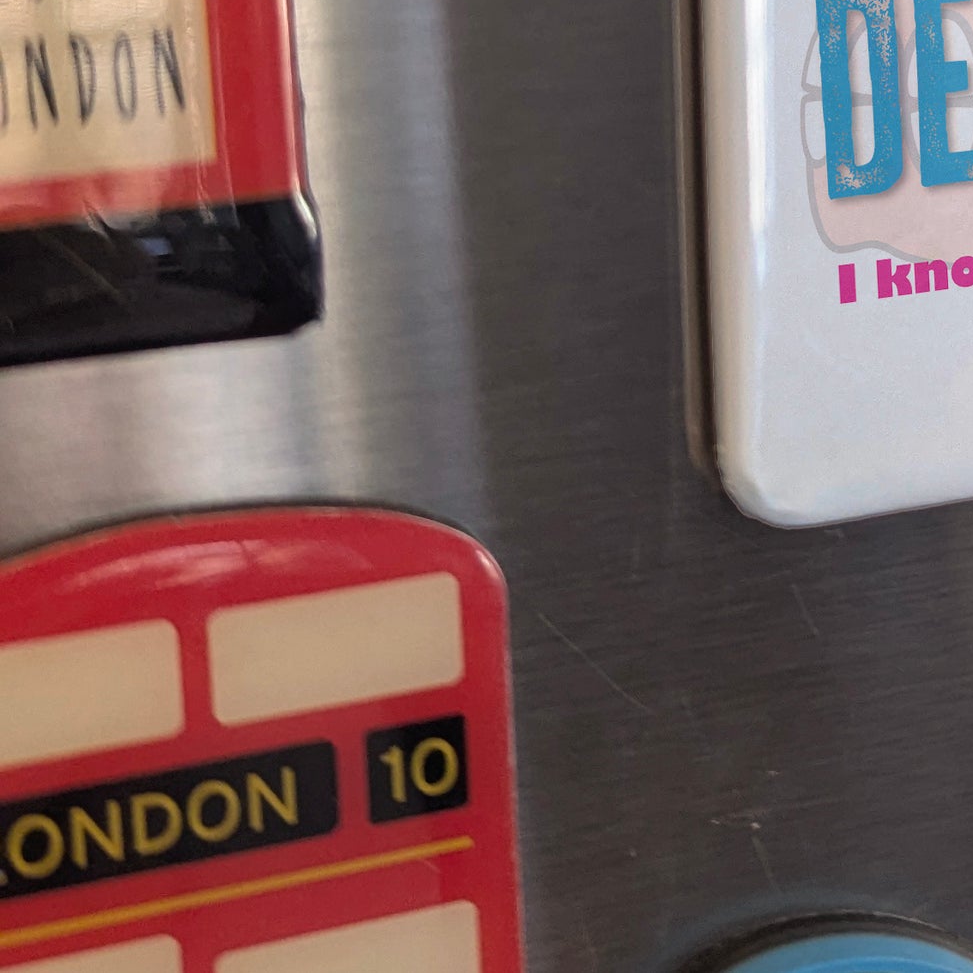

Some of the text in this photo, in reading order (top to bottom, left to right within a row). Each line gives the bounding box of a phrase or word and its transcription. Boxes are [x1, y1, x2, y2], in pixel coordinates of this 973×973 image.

[838, 264, 858, 305] I
[0, 737, 459, 886] ONDON 10
